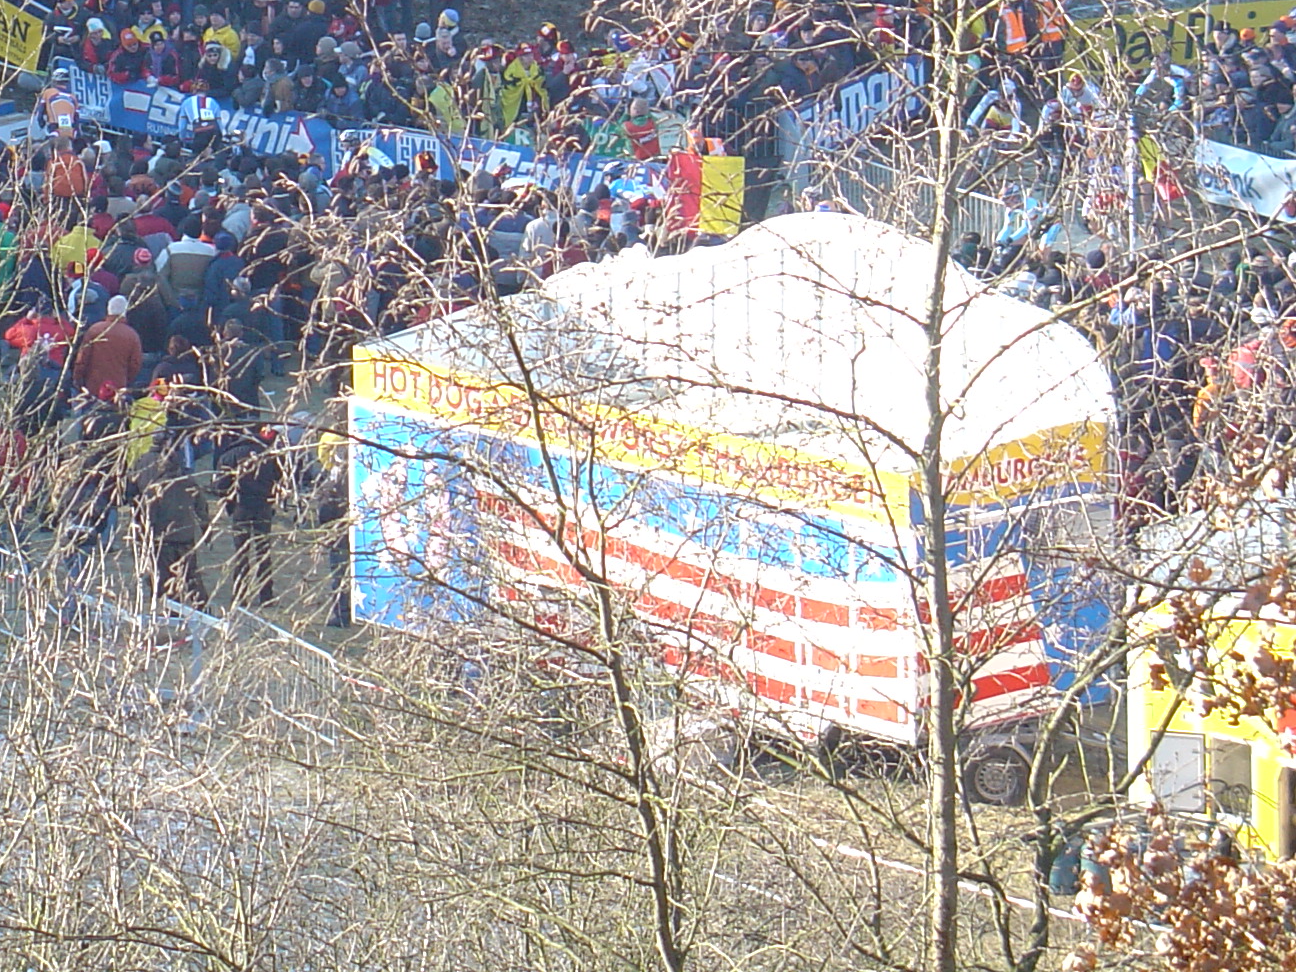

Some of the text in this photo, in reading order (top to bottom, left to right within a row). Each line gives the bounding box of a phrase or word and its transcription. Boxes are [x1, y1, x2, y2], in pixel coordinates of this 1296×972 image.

[148, 86, 295, 155] Stini
[372, 360, 422, 402] HOT
[428, 373, 483, 416] DOG
